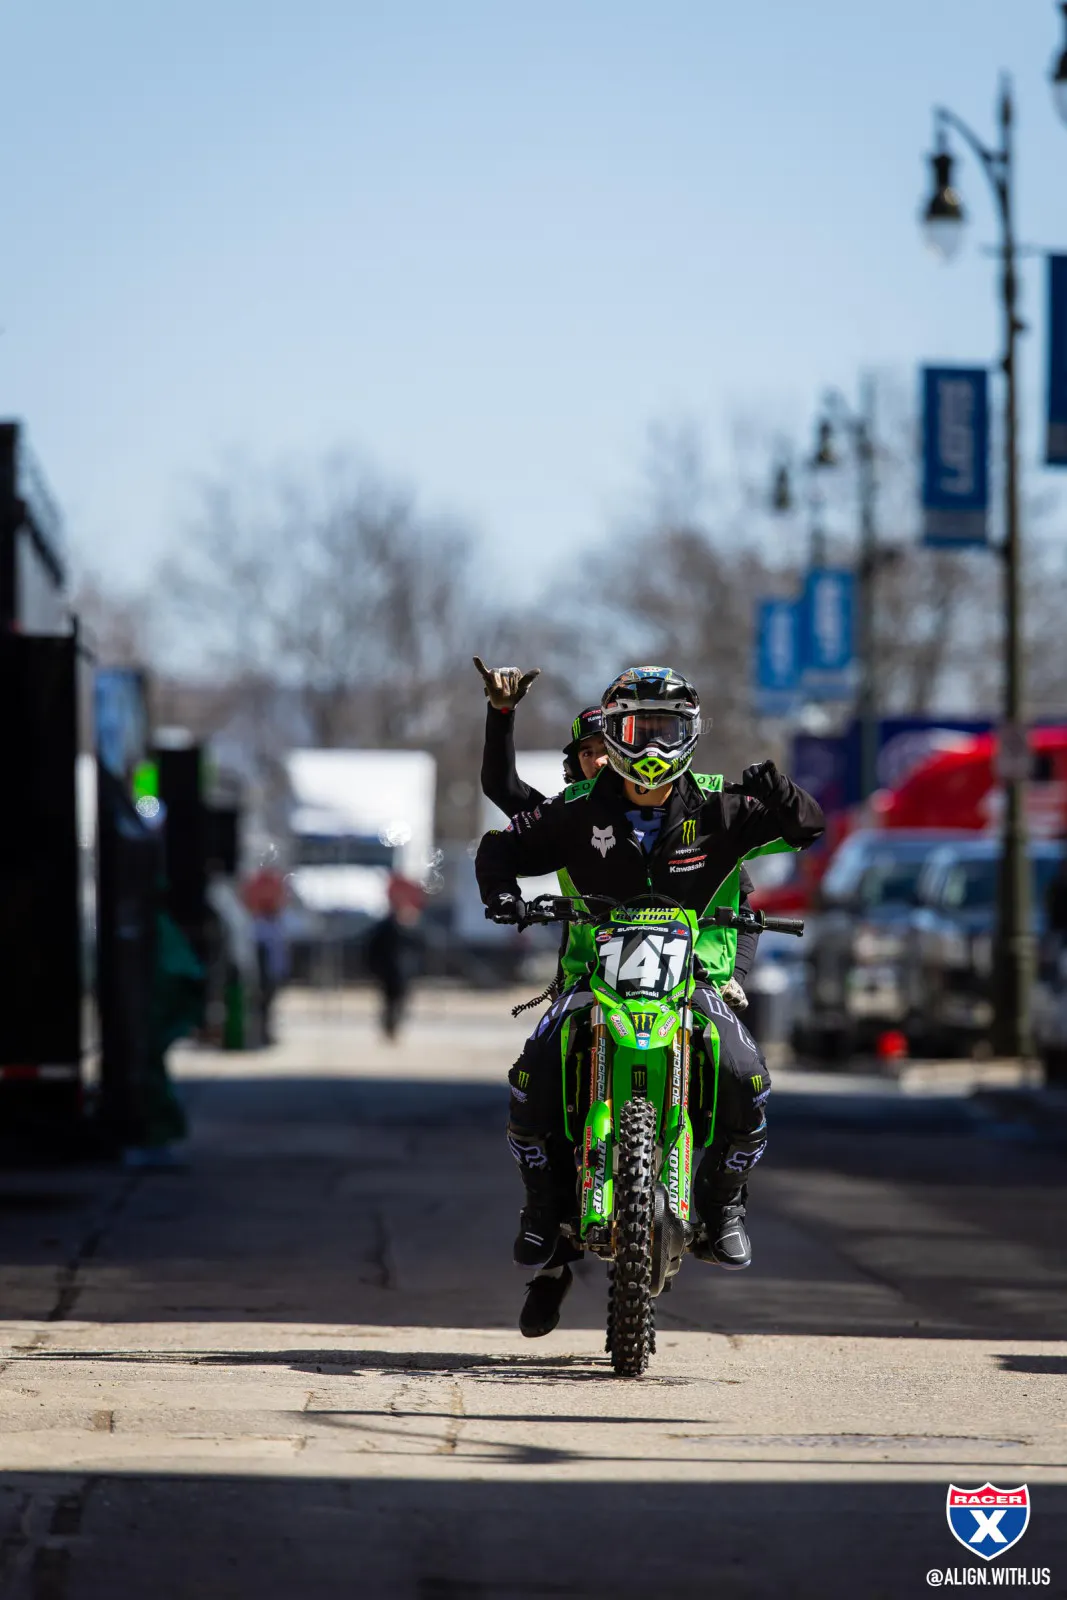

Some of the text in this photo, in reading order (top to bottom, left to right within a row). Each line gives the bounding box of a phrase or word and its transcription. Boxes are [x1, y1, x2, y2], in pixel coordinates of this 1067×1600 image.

[669, 860, 706, 874] Kawasaki
[616, 925, 669, 933] SUPERCROSS
[599, 934, 688, 993] 141
[625, 989, 660, 999] Kawasaki
[597, 1063, 606, 1102] CIRCUI
[671, 1086, 681, 1107] RO
[684, 1132, 692, 1174] BRAKING
[592, 1138, 607, 1214] DUNLOP
[668, 1144, 680, 1215] DUNLOP
